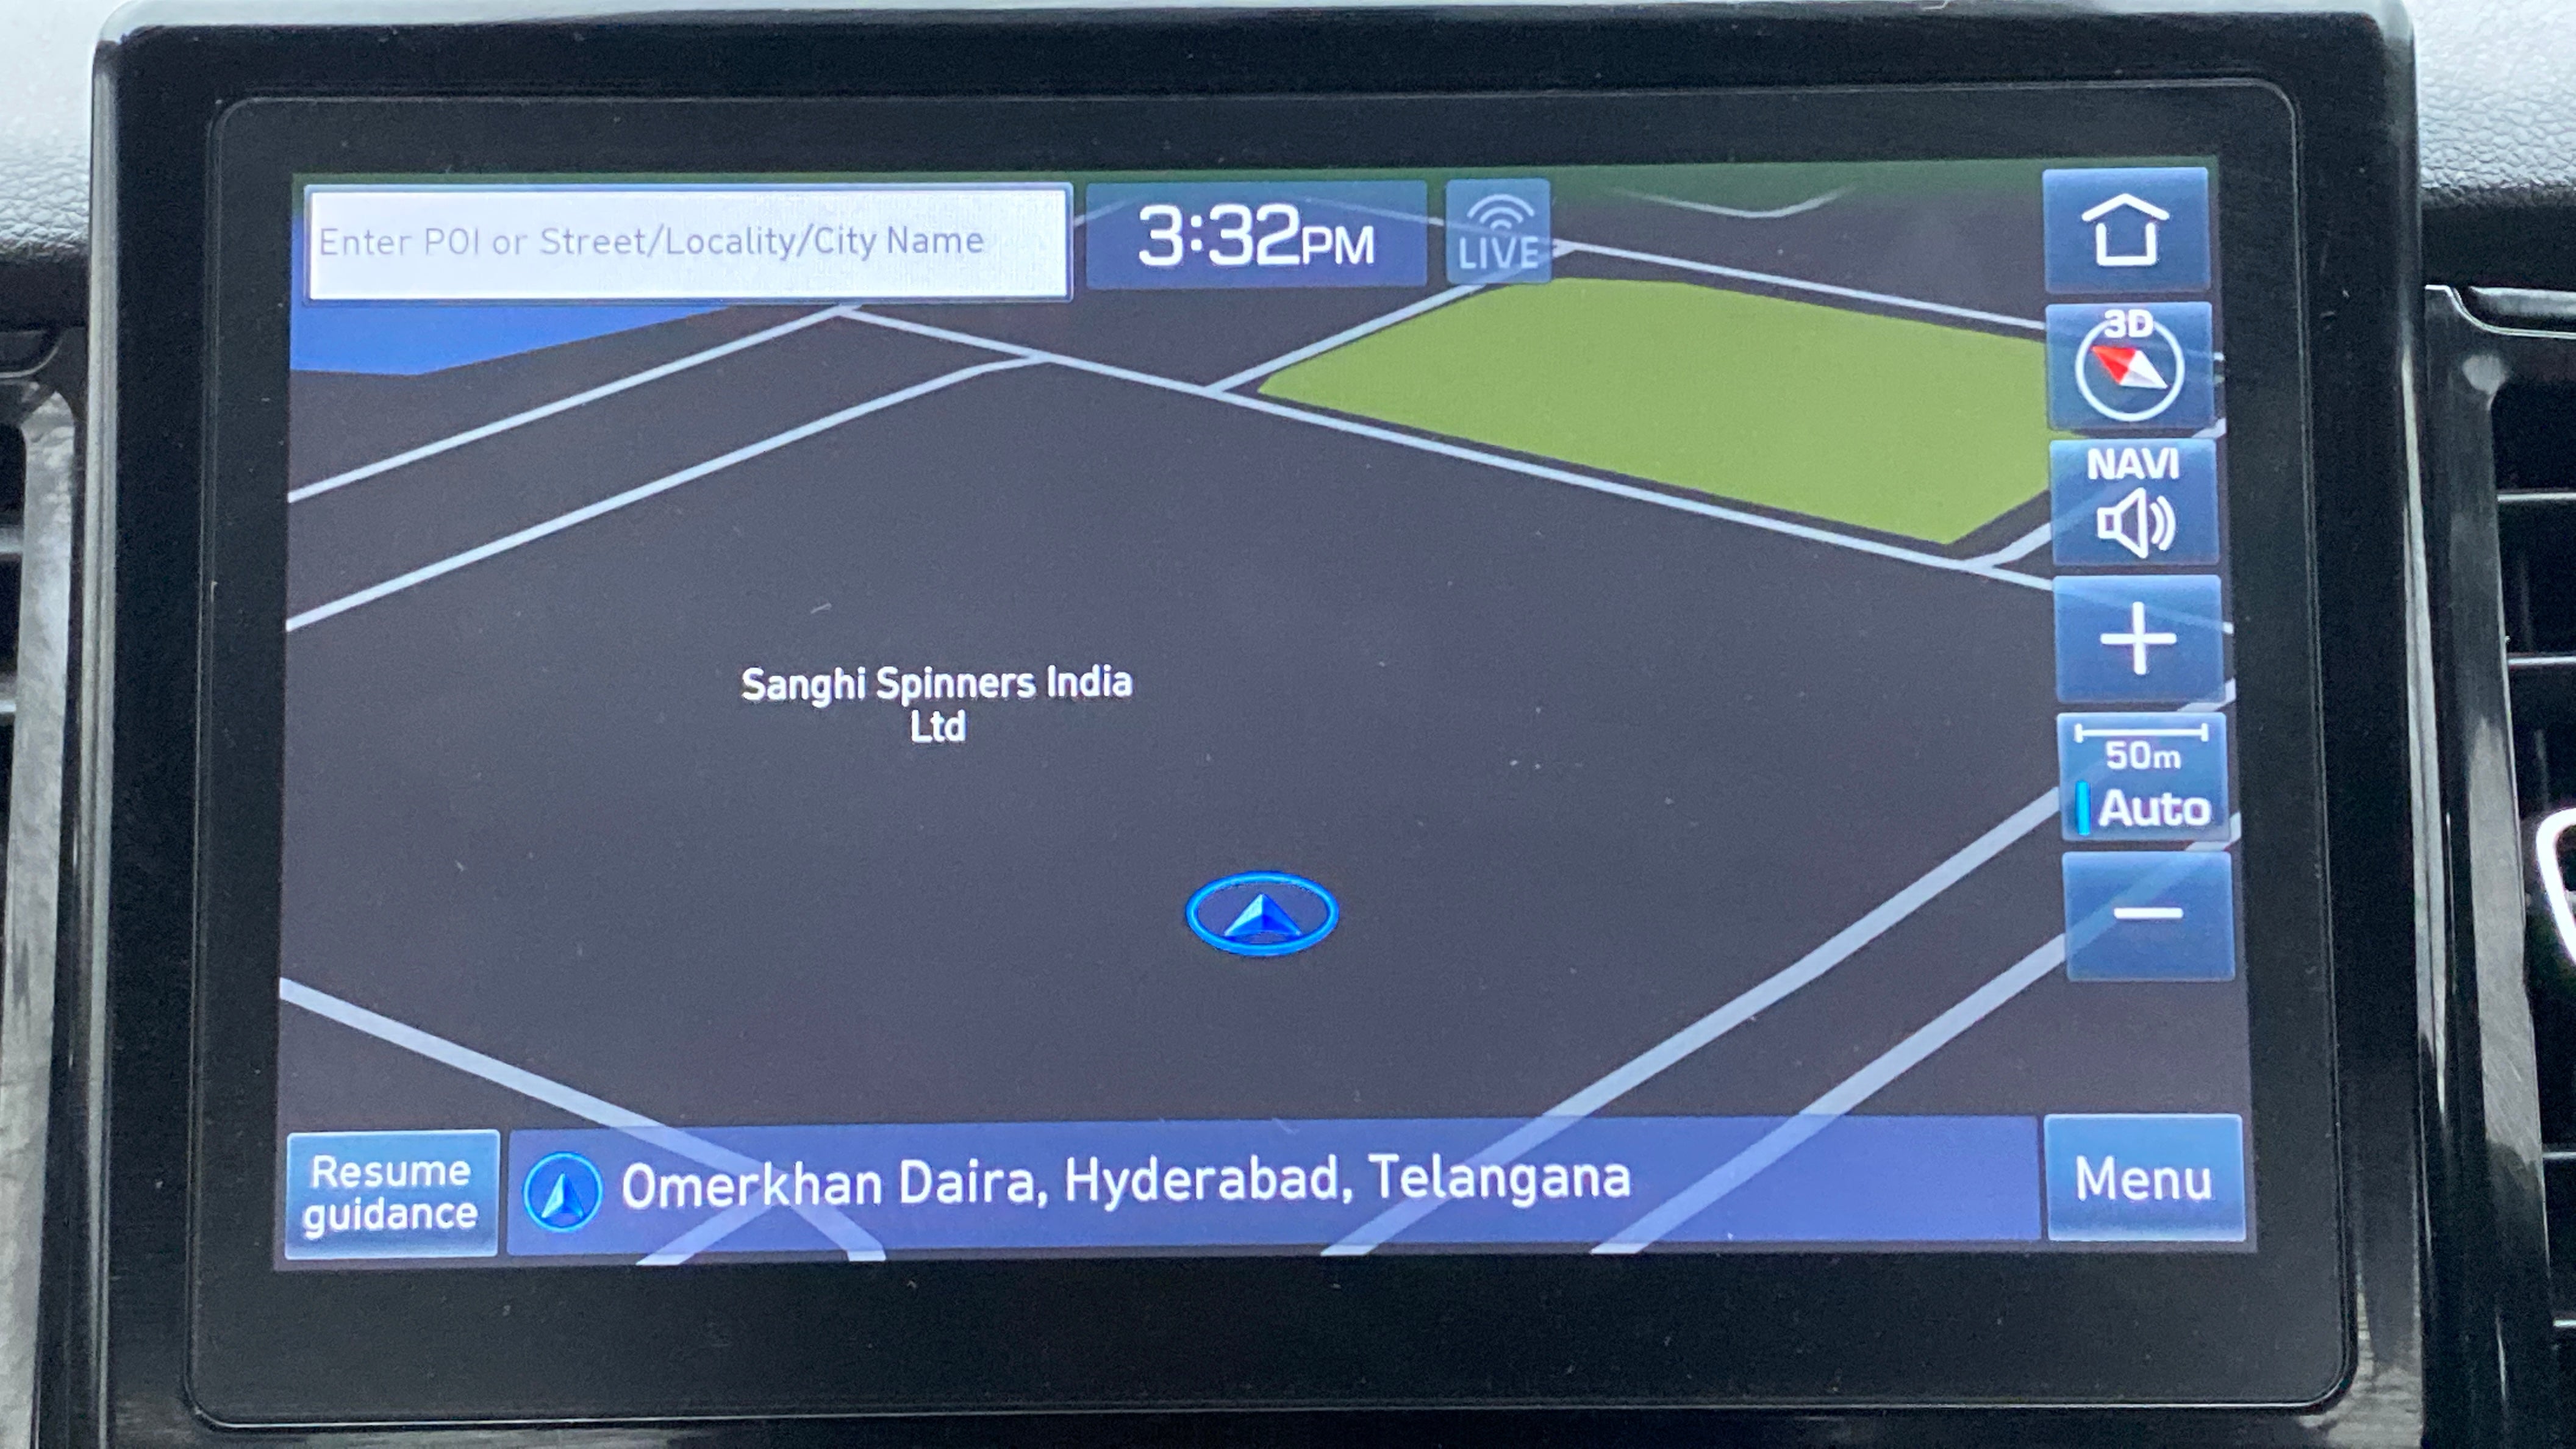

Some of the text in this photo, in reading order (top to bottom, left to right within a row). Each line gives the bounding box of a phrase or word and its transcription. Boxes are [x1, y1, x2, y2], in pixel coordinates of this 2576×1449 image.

[320, 223, 986, 261] Enter POI or Street/Locality/City Name
[1138, 203, 1375, 267] 3:32PM
[1459, 236, 1540, 270] LIVE
[2103, 309, 2155, 338] 3D
[2087, 447, 2179, 481] NAVI
[741, 664, 1134, 708] Sanghi Spinners India
[911, 709, 967, 743] Ltd
[2105, 740, 2181, 770] 50m
[2098, 788, 2213, 828] Auto
[311, 1154, 471, 1189] Resume
[621, 1152, 1631, 1211] Omerkhan Daira, Hyderabad, Telangana
[2076, 1154, 2213, 1201] Menu
[301, 1194, 478, 1240] guidance
